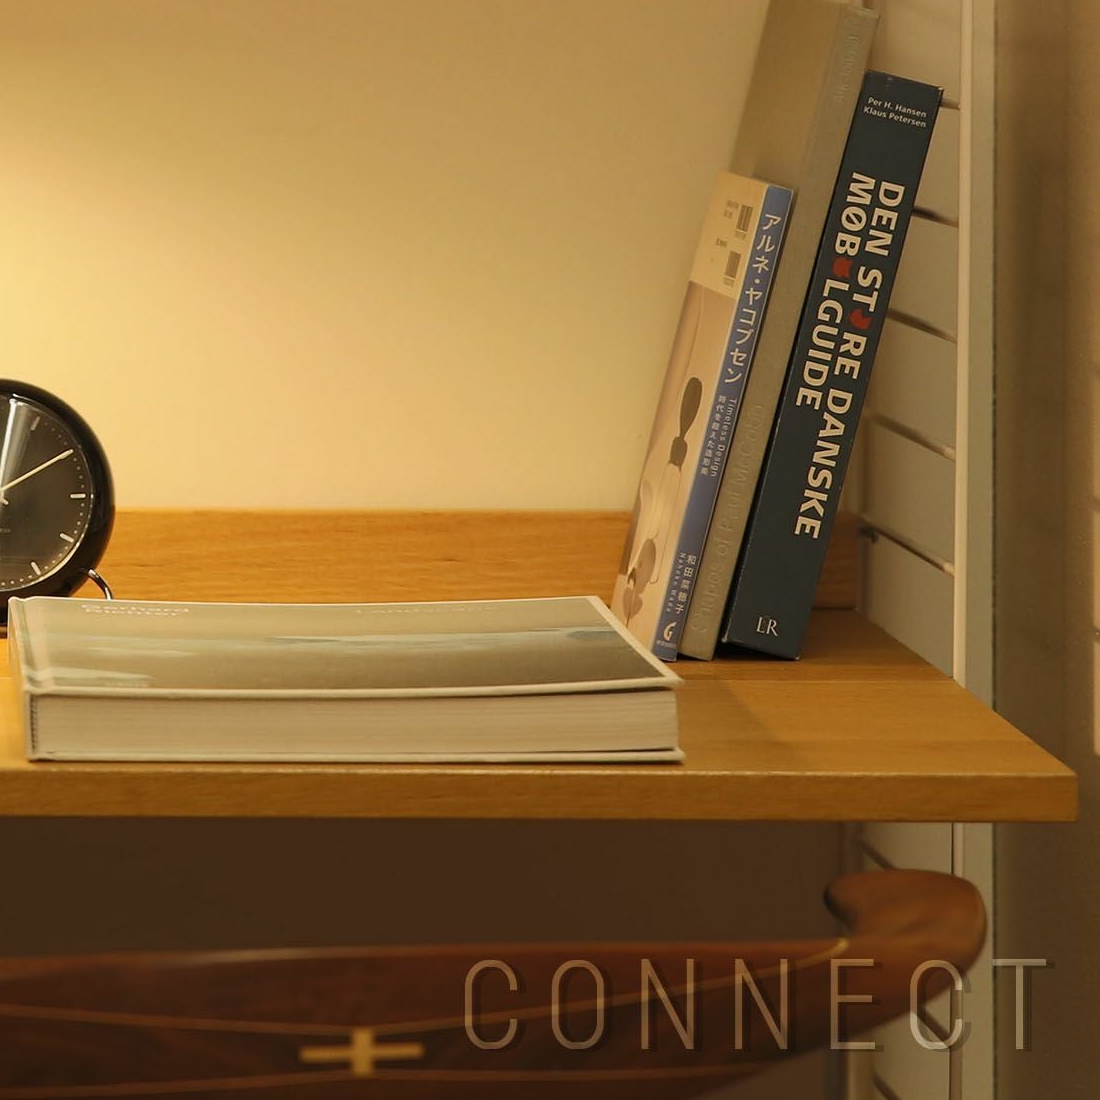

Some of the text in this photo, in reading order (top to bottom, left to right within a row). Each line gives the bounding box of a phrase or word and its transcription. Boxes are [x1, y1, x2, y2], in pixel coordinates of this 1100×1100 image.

[863, 106, 927, 128] Klaus Petersen
[867, 96, 927, 118] Per H. Hansen
[723, 213, 782, 384] アルネ・ヤコブセン
[795, 171, 877, 410] MØBLGUIDE
[794, 181, 905, 540] DEN STRE DANSKE
[710, 398, 737, 477] Timeless Design
[757, 616, 780, 637] LR
